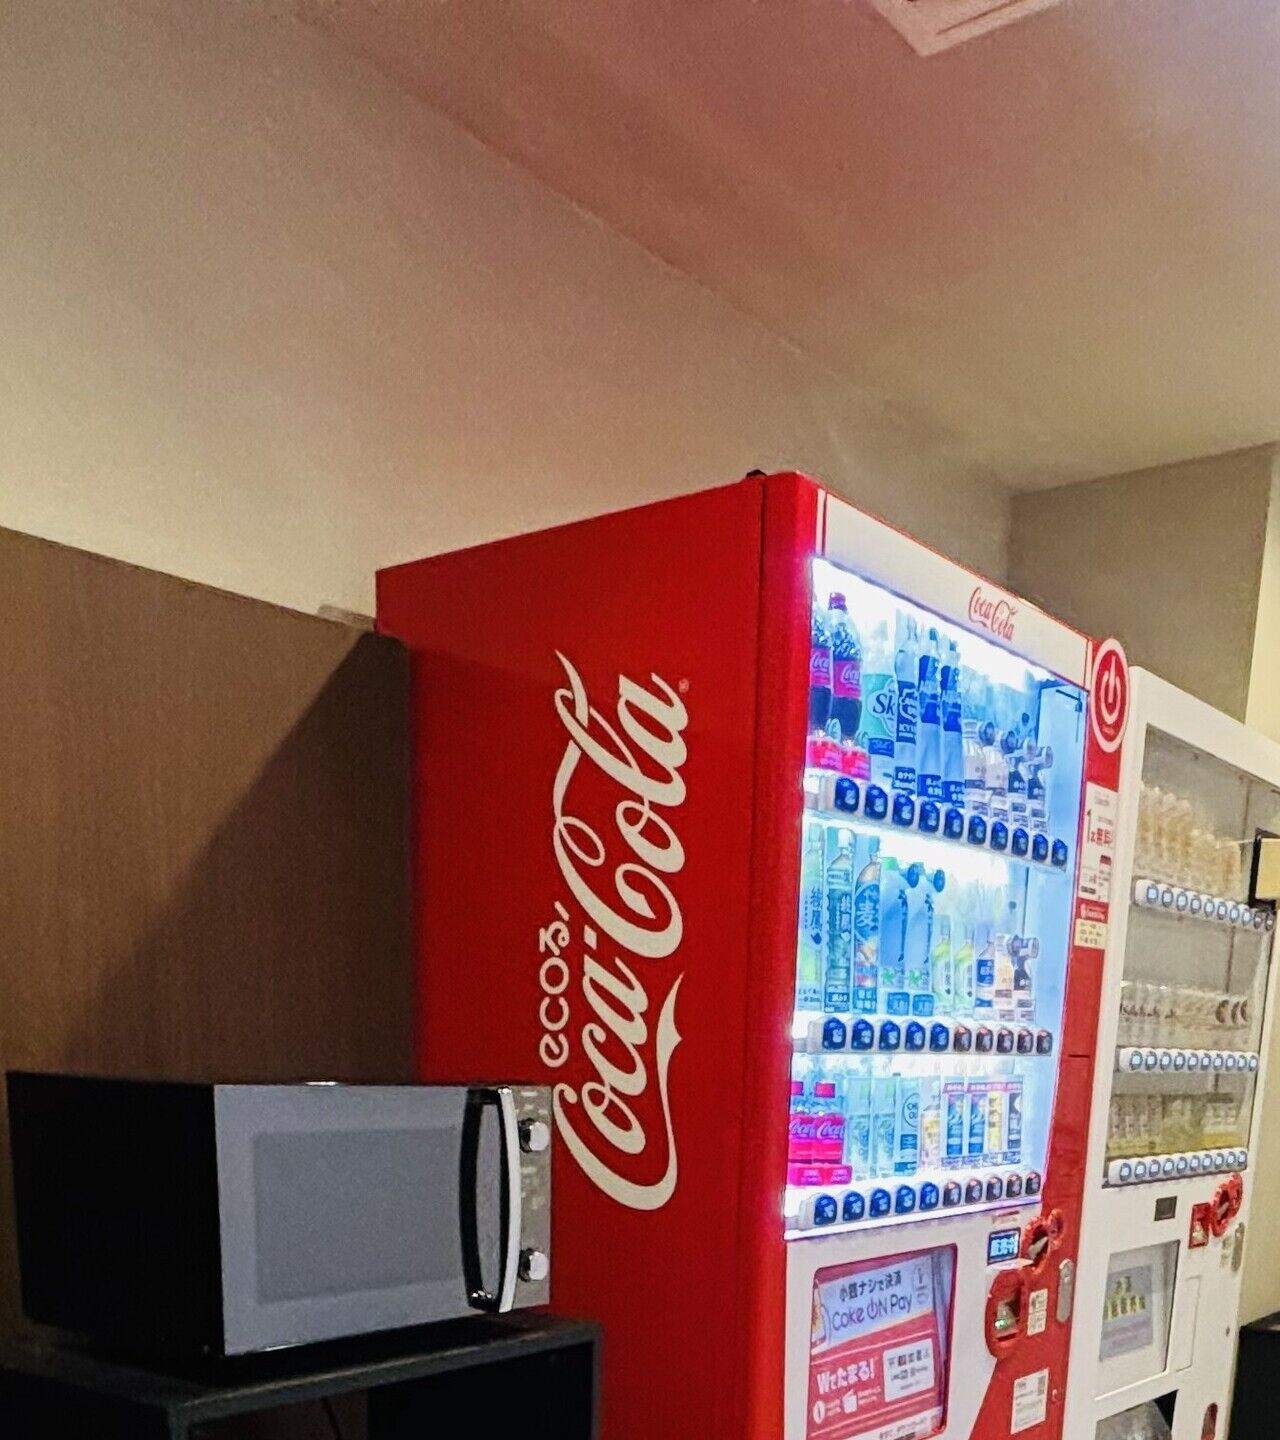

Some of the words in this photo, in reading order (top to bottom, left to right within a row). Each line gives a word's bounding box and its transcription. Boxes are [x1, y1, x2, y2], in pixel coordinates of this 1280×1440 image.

[552, 650, 689, 1212] Coca-Cola
[832, 1307, 865, 1331] Coke
[890, 1294, 913, 1314] Pay
